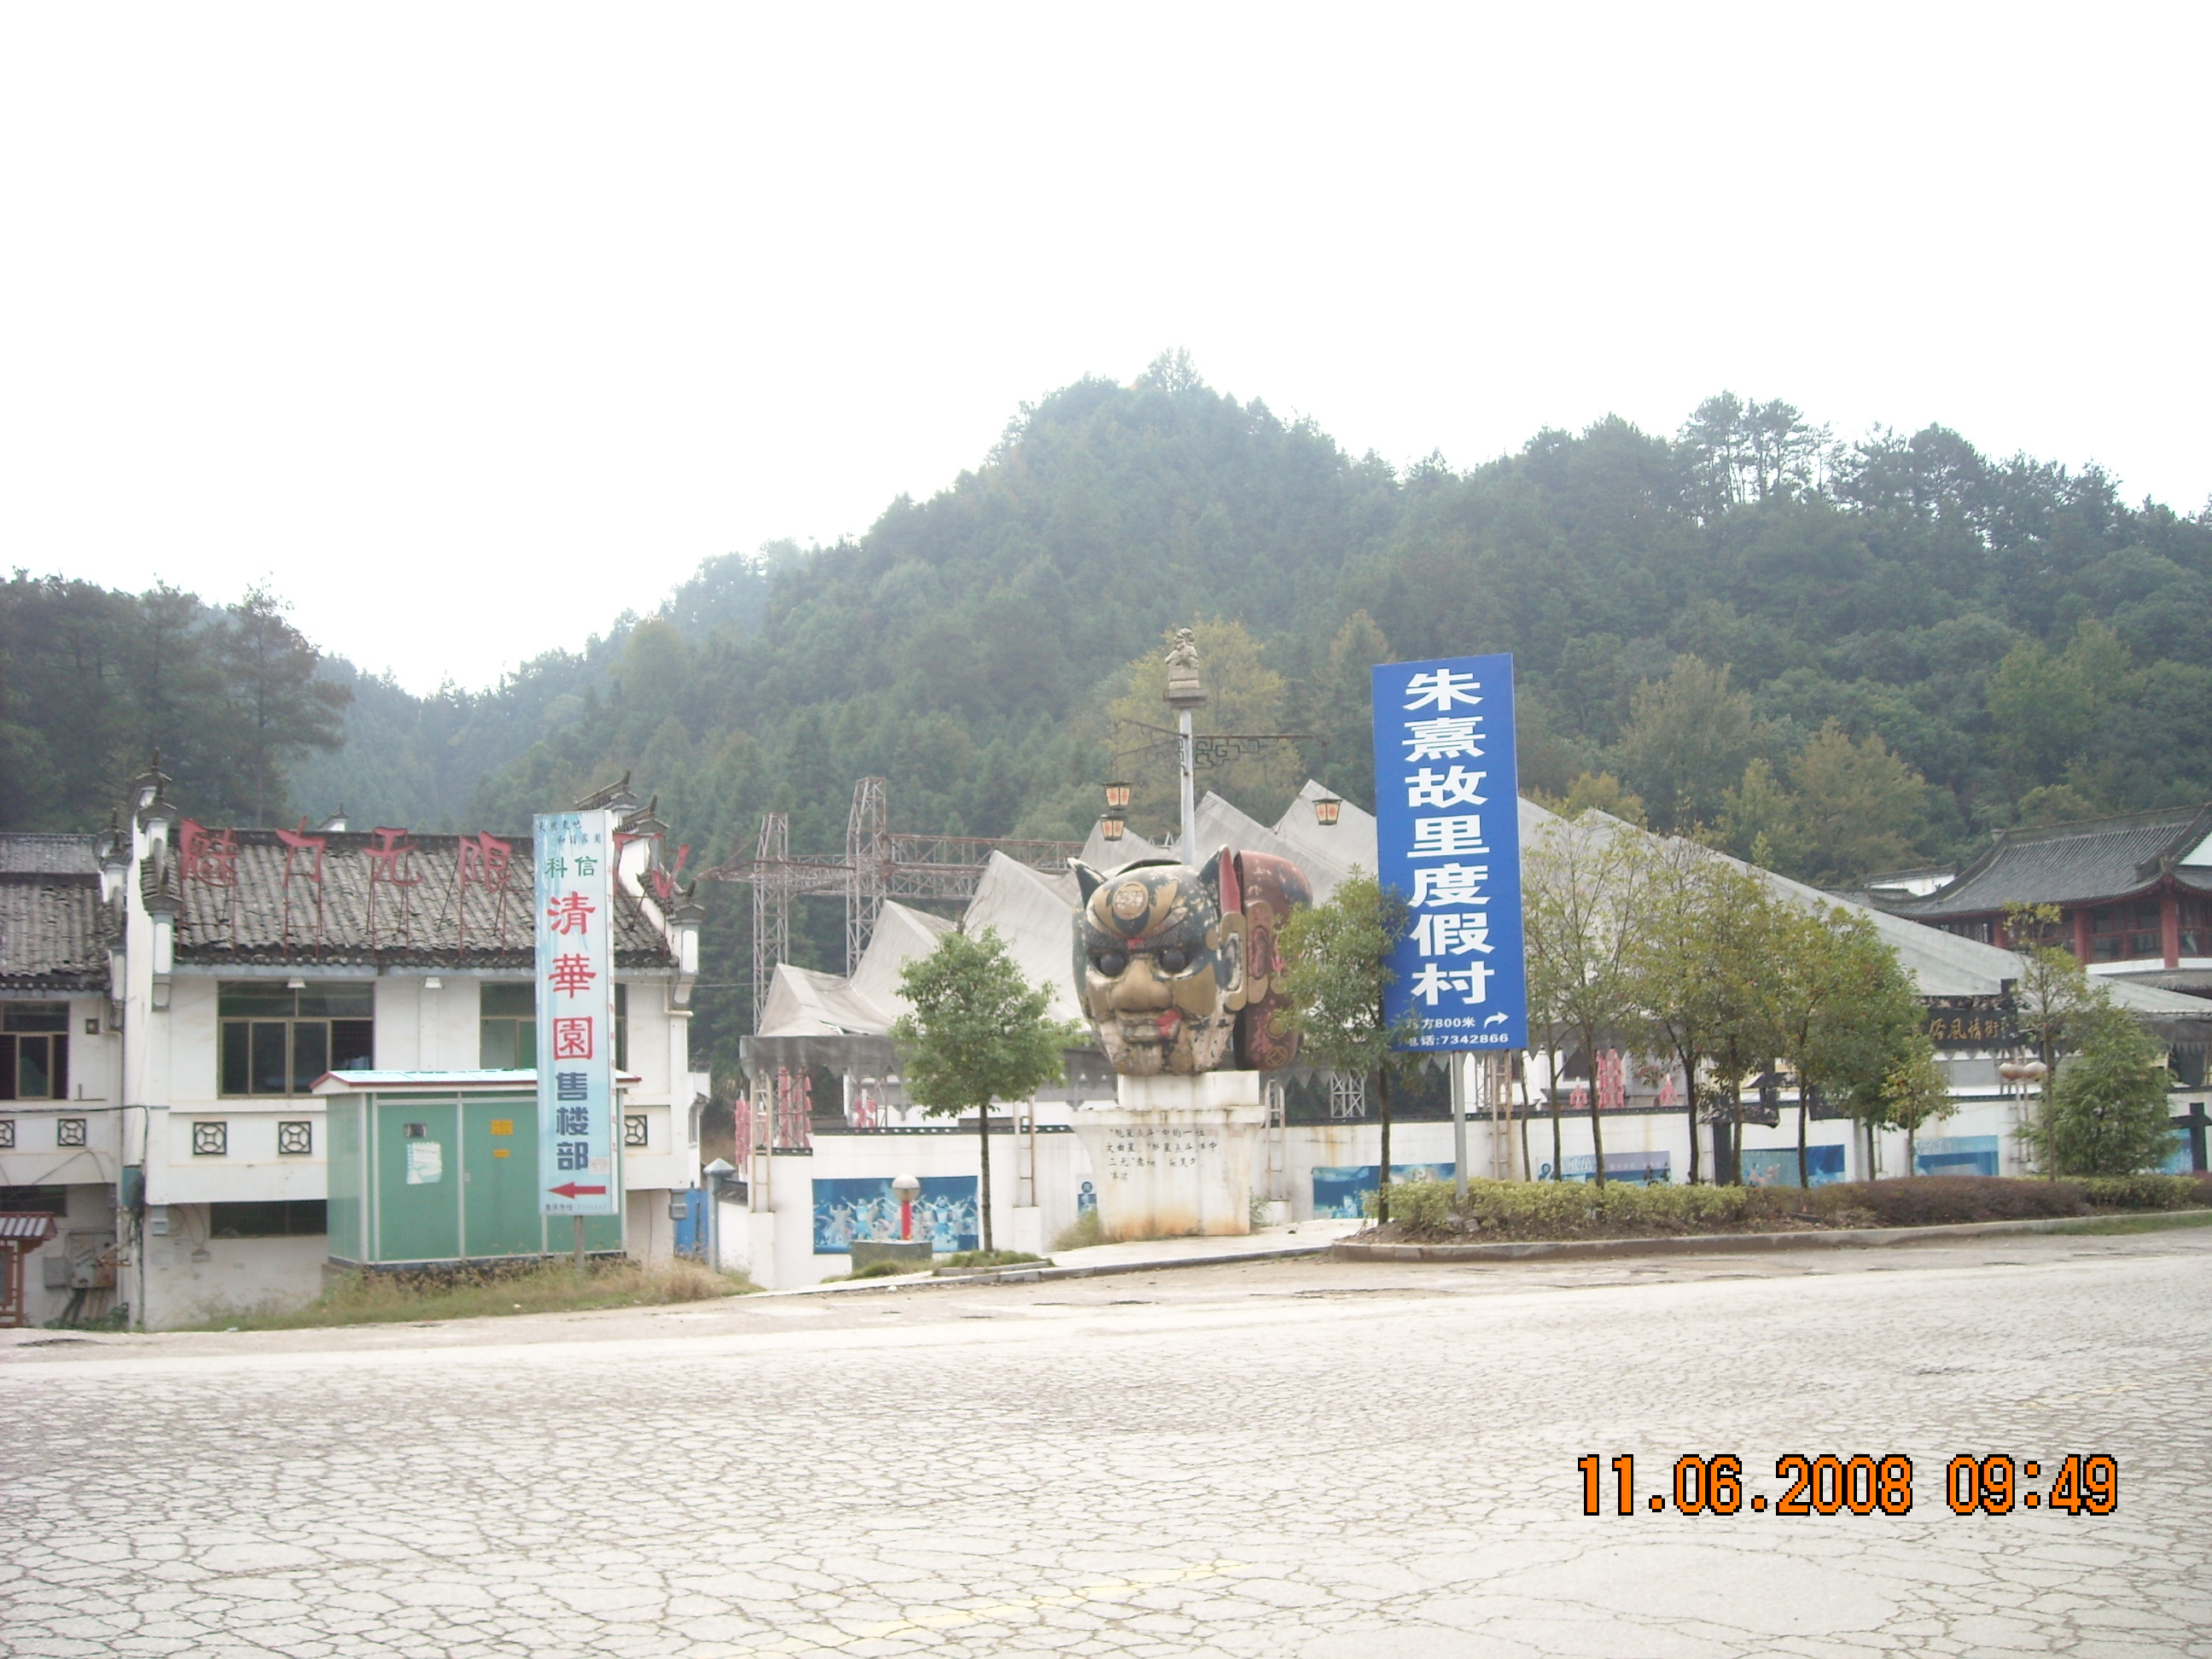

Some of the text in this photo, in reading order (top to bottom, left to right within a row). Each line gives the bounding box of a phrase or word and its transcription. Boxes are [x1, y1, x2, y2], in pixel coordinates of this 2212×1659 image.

[544, 855, 598, 879] 科信
[1402, 668, 1495, 1005] 朱熹故里度假村
[556, 1072, 589, 1170] 售楼部
